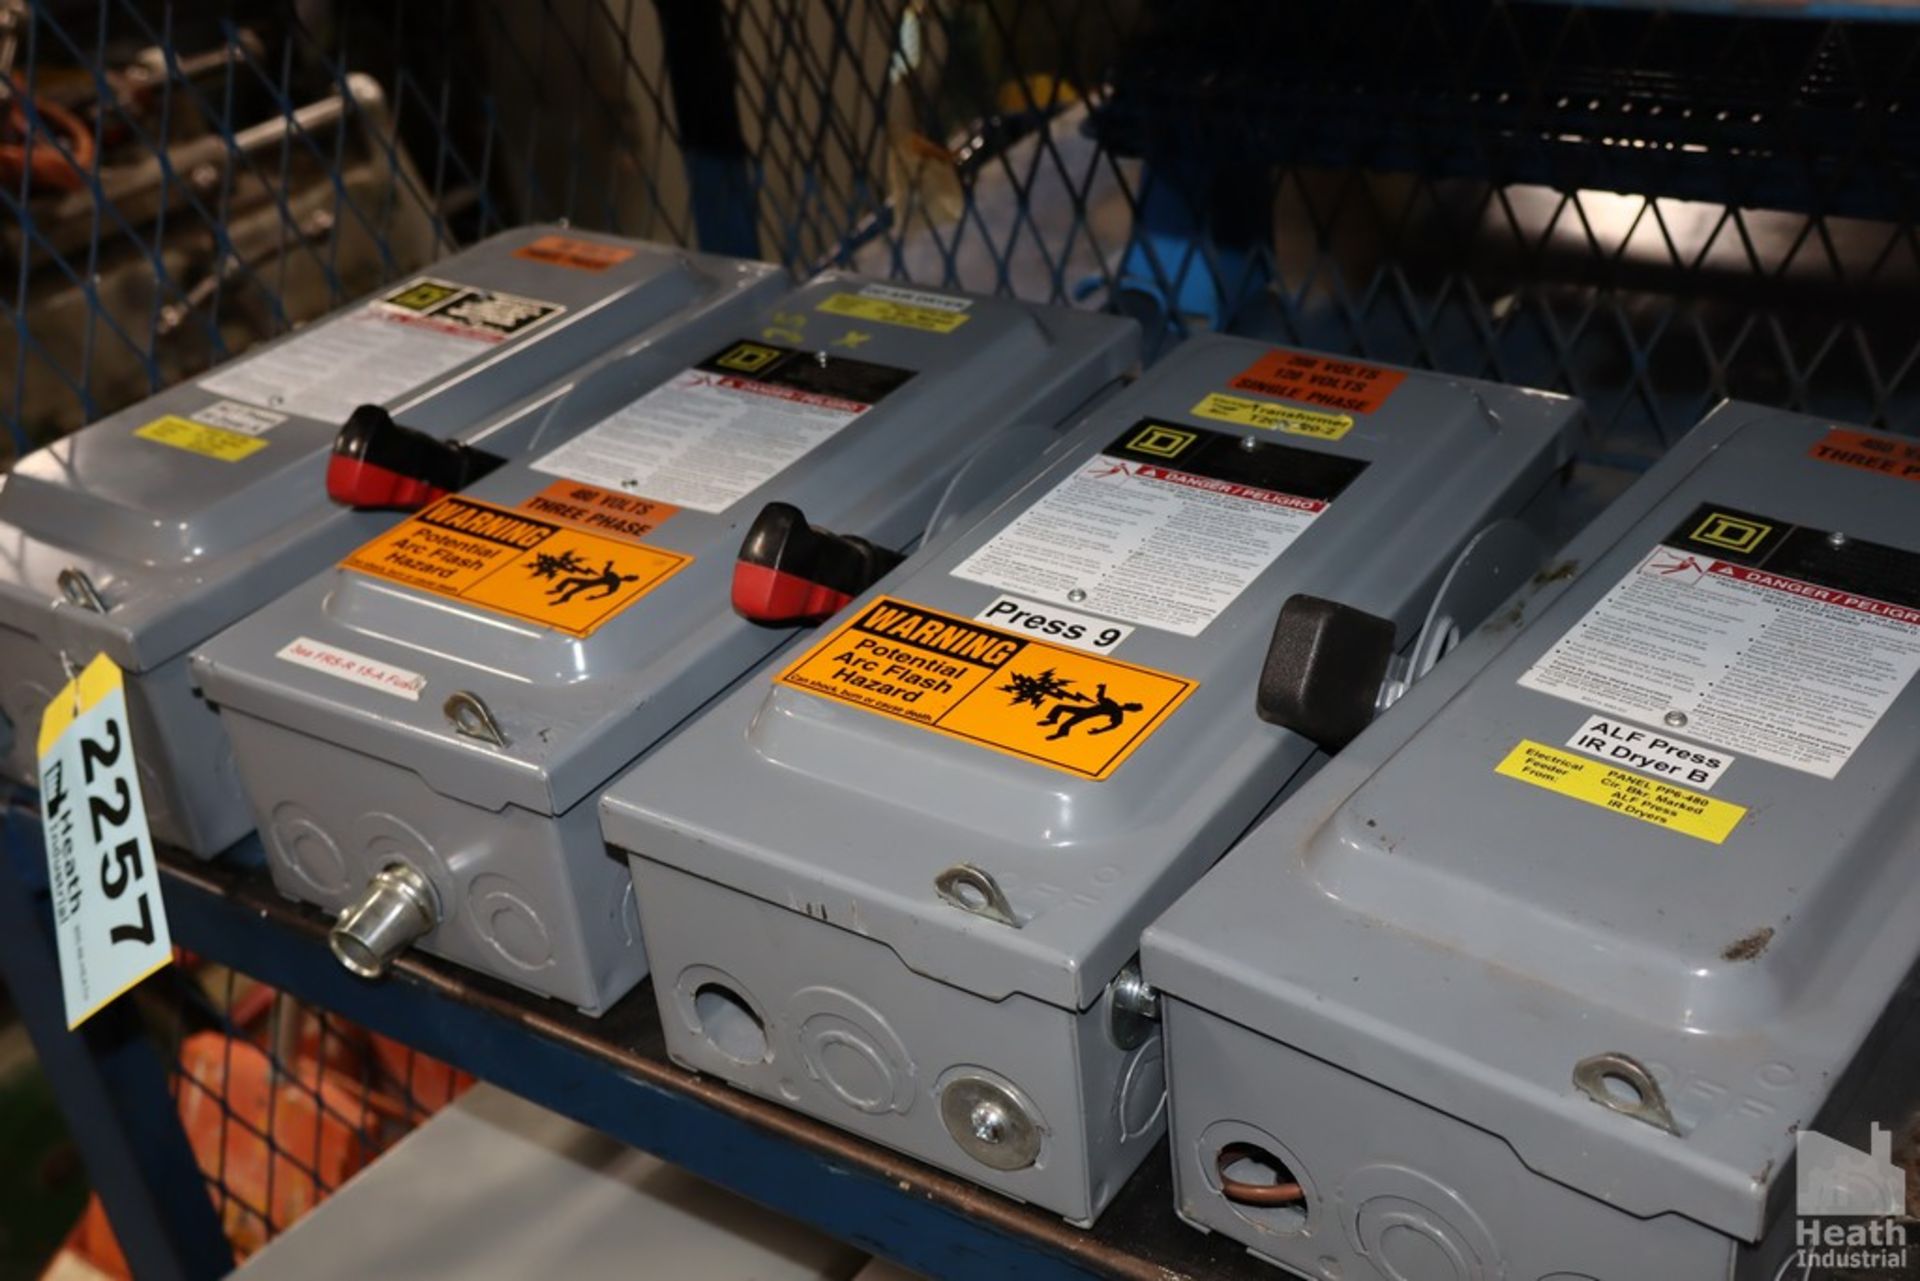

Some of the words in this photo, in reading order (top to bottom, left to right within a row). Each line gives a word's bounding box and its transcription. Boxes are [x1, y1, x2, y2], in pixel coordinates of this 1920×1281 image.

[1309, 371, 1368, 393] VOLTS
[1324, 359, 1380, 381] VOLTS
[1235, 377, 1299, 399] SINGLE
[1306, 389, 1371, 411] PHASE
[1251, 402, 1352, 428] Transformer
[600, 492, 655, 517] VOLTS
[1165, 472, 1231, 493] DANGER
[1241, 489, 1315, 510] PELIGRO
[421, 499, 556, 550] WARNING
[525, 495, 585, 522] THREE
[591, 512, 652, 538] PHASE
[390, 538, 424, 556] Arc
[430, 543, 486, 572] Flash
[413, 527, 503, 560] Potential
[384, 551, 458, 580] Hazard
[1745, 571, 1830, 600] DANGER
[863, 603, 1019, 667] WARNING
[985, 599, 1087, 642] Press
[1093, 626, 1123, 649] 9
[833, 650, 882, 672] Arc
[885, 658, 954, 695] Flash
[853, 637, 970, 681] Potential
[789, 672, 809, 683] Can
[839, 688, 864, 700] burn
[863, 696, 876, 704] or
[874, 700, 905, 713] cause
[831, 667, 924, 703] Hazard
[1524, 747, 1585, 772] Electrical
[1576, 733, 1610, 751] IR
[1609, 744, 1683, 777] Dryer
[1686, 768, 1710, 784] B
[1590, 721, 1647, 743] ALF
[1647, 739, 1722, 770] Press
[1521, 765, 1559, 784] From:
[1524, 756, 1570, 777] Feeder
[1607, 769, 1653, 789] PANEL
[1599, 777, 1623, 791] Cir.
[1654, 792, 1704, 816] Marked
[1606, 799, 1625, 810] IR
[1624, 804, 1669, 825] Dryers
[1611, 790, 1637, 804] ALF
[1640, 798, 1679, 818] Press
[79, 717, 156, 947] 2257
[49, 824, 70, 926] Industrial
[56, 808, 81, 916] Heath
